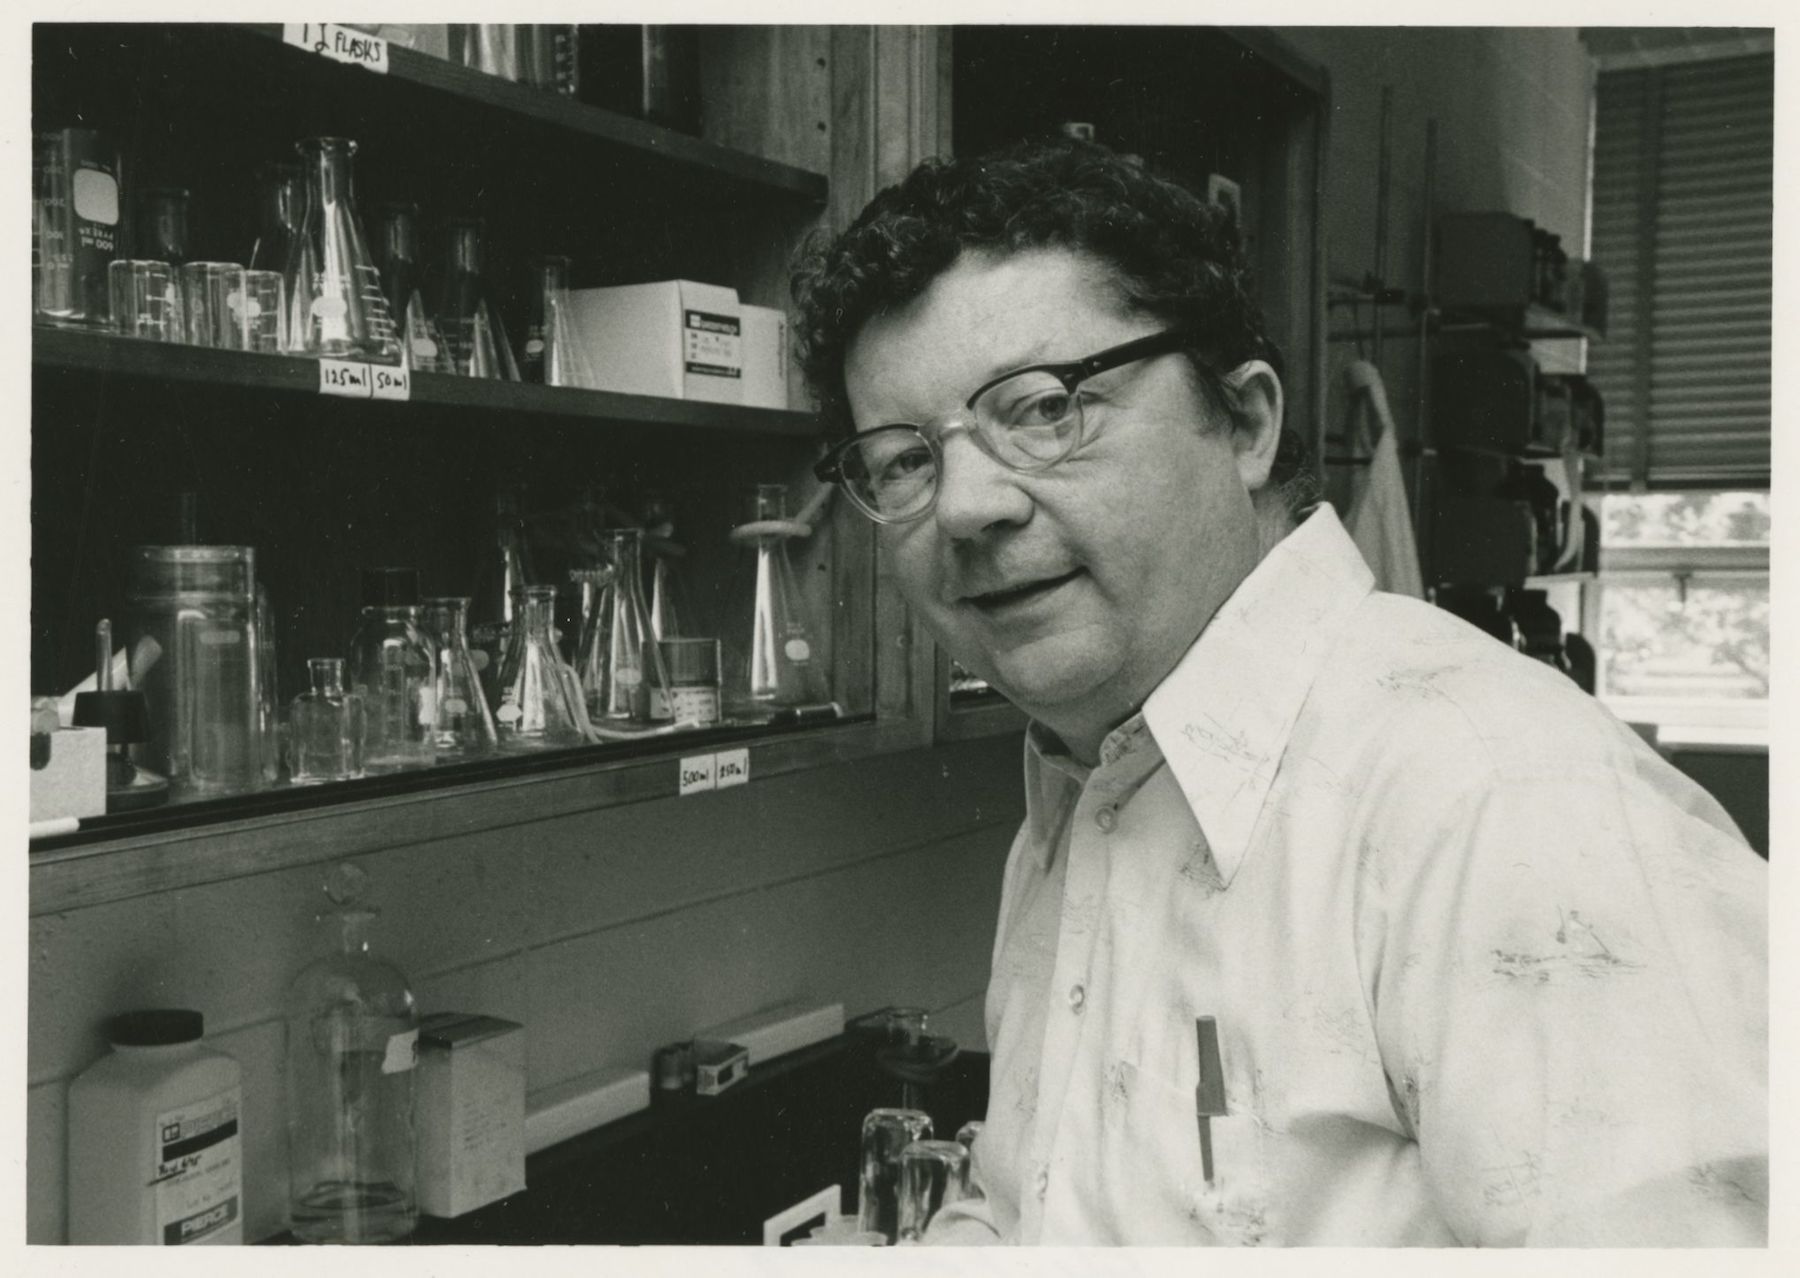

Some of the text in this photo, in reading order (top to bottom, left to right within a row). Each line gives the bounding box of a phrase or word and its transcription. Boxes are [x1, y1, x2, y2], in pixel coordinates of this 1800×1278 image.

[335, 31, 381, 62] FLASKS
[325, 367, 408, 390] 125ml 50ml
